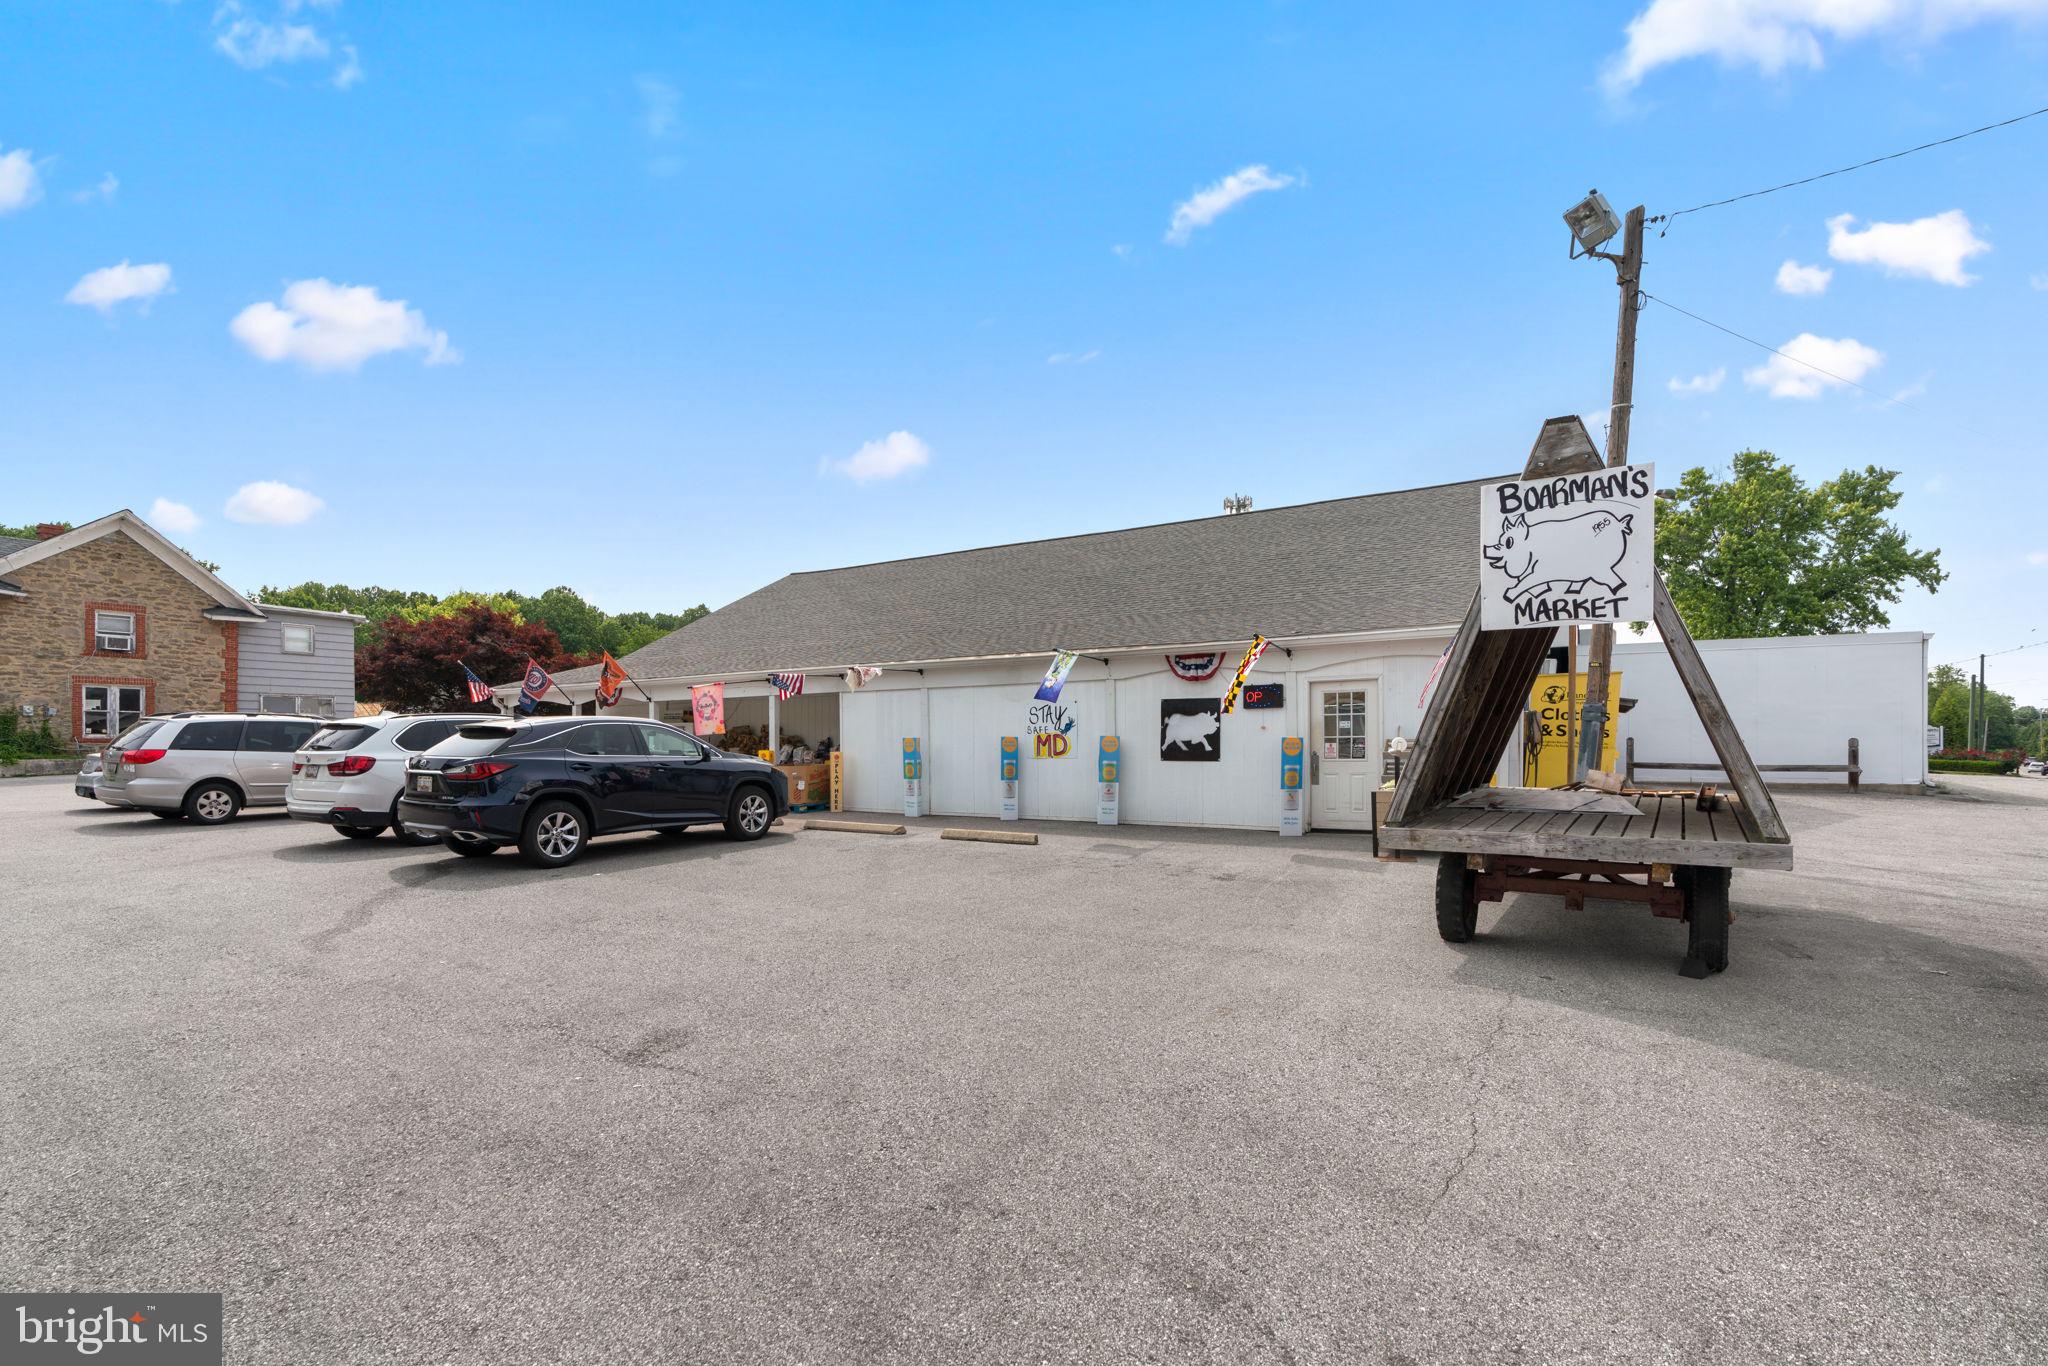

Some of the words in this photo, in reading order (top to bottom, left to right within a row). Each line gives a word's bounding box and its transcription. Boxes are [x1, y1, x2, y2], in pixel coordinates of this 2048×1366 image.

[1497, 466, 1650, 514] BOARMAN'S
[1514, 596, 1629, 625] MARKET
[1029, 704, 1068, 731] STAY
[1541, 707, 1611, 722] Clots
[1026, 725, 1049, 735] SAFE
[1541, 723, 1553, 737] &
[1036, 733, 1068, 757] MD
